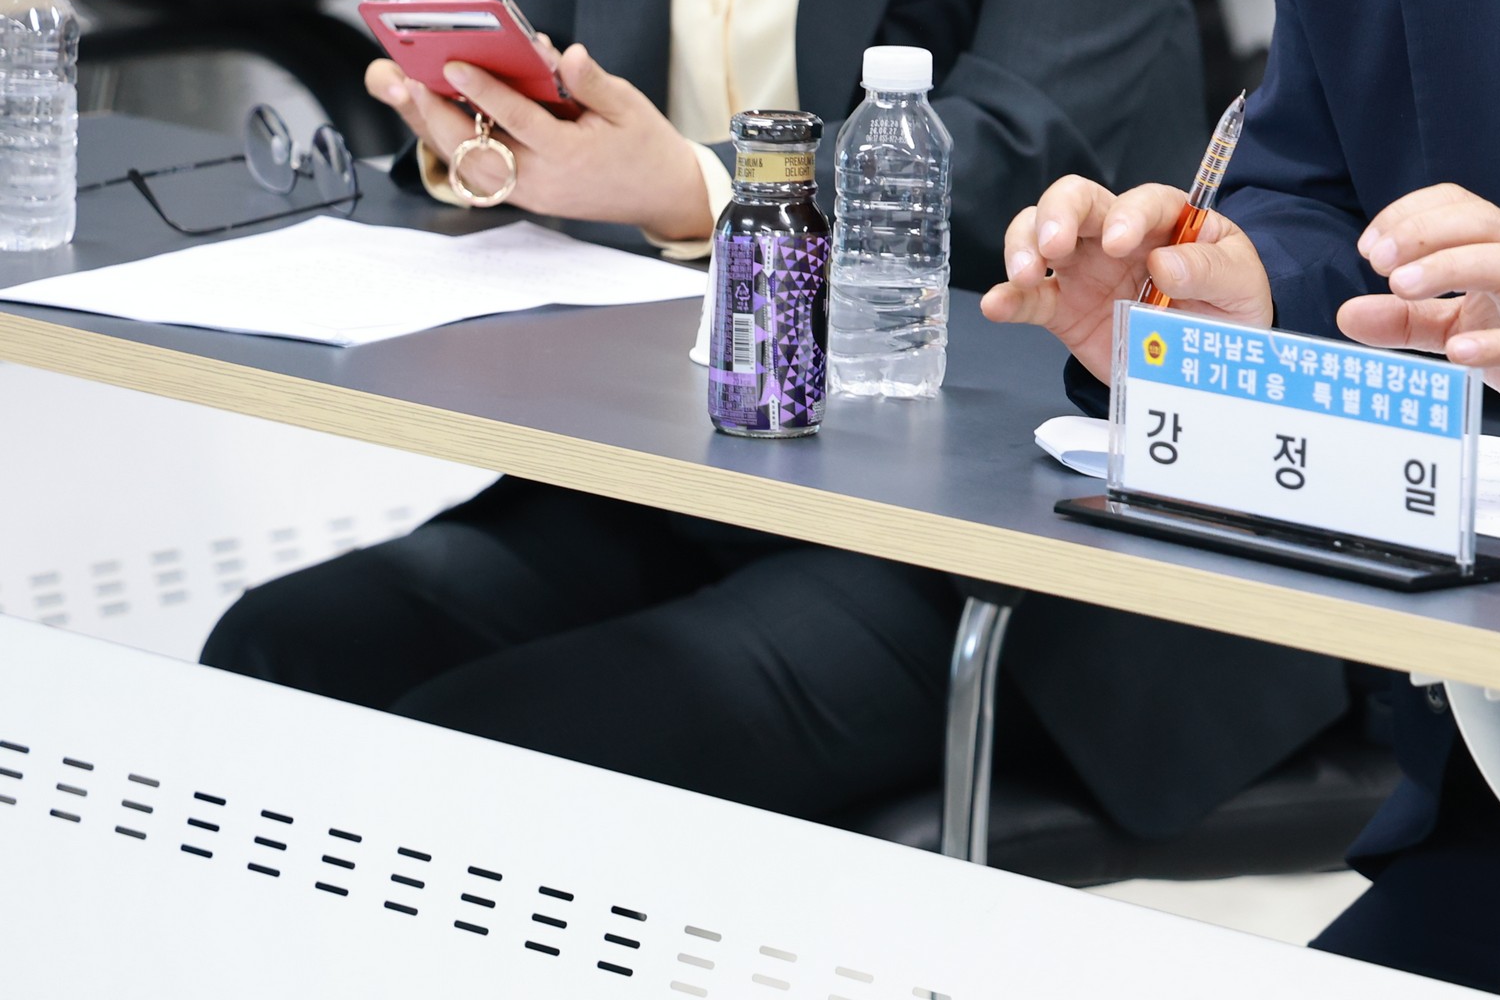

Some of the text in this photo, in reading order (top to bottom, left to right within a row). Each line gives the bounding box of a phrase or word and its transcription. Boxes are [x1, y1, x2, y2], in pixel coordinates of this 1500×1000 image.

[1181, 358, 1448, 432] 위기대응 특별위원회
[1182, 327, 1449, 401] 전라남도 석유화학철강산업
